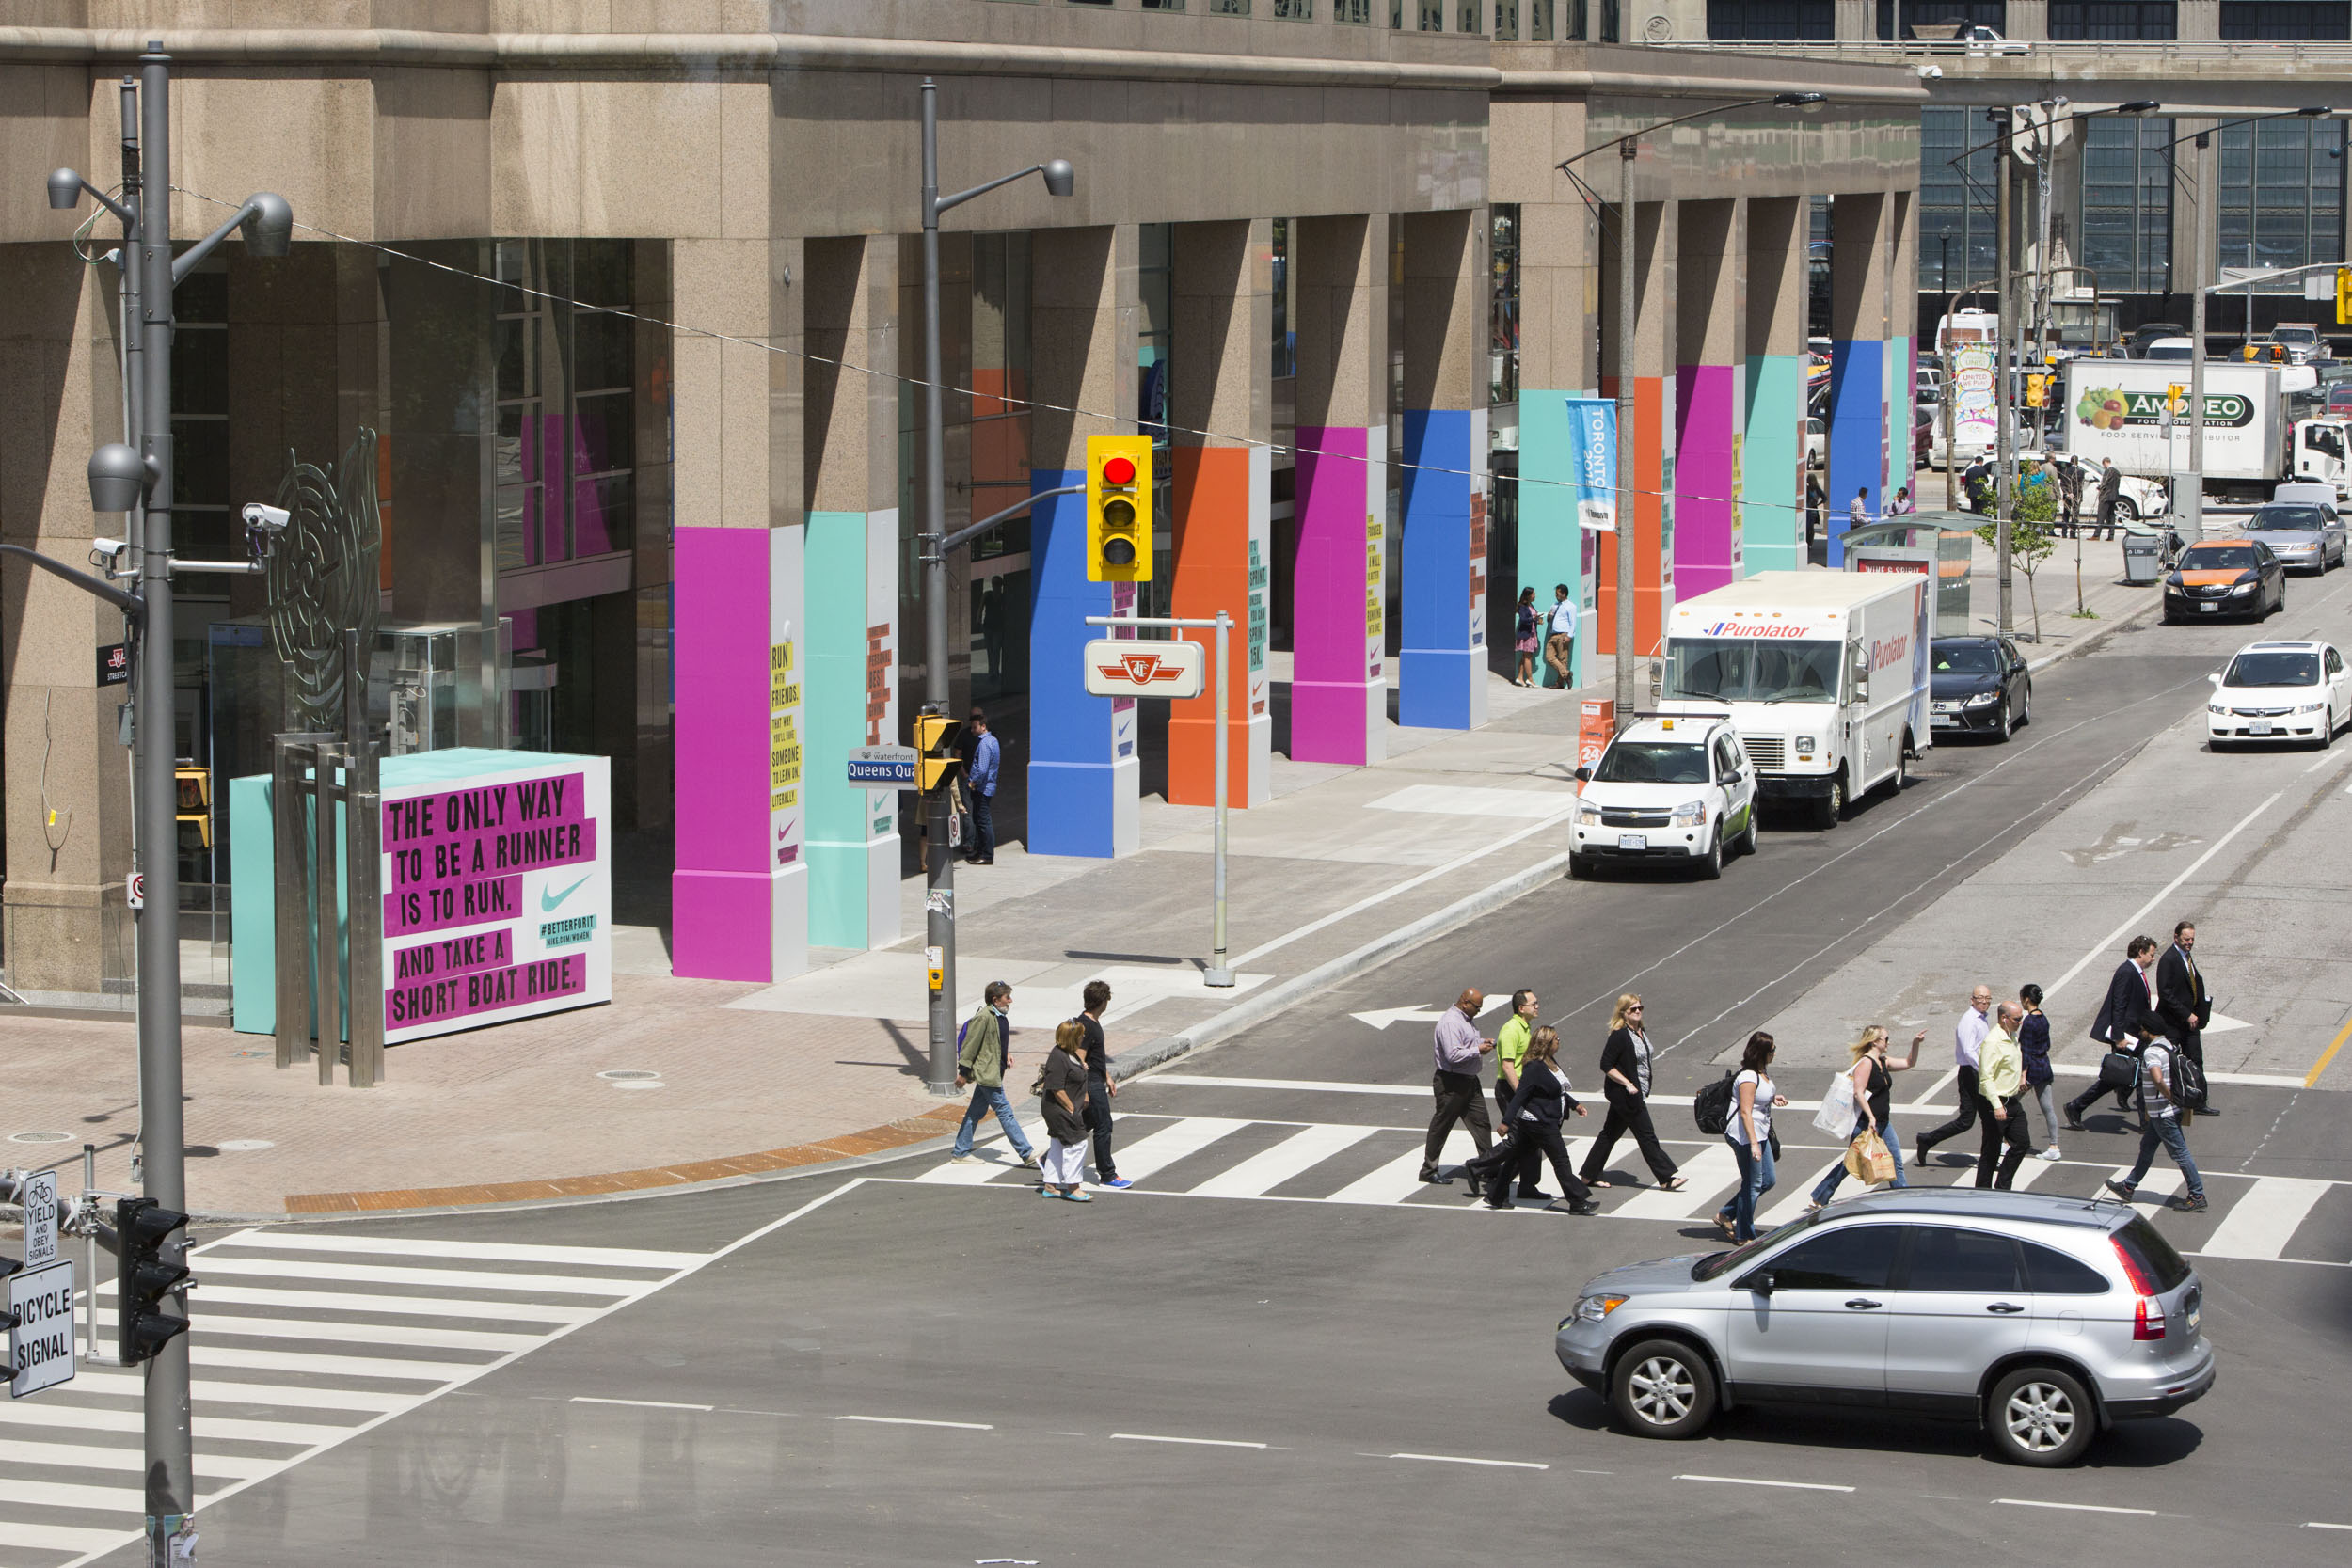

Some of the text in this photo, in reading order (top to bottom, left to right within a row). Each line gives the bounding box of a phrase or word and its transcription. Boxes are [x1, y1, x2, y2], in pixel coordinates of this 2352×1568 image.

[1592, 408, 1605, 488] TORONTO
[1583, 450, 1593, 487] 2015
[1250, 567, 1266, 586] SPRINT.
[1250, 624, 1265, 642] SPRINT
[1722, 622, 1810, 638] Purolator
[772, 644, 788, 670] RUN
[1875, 632, 1907, 671] Purolator
[107, 671, 127, 681] STREETCA
[869, 668, 883, 688] BEST
[772, 685, 799, 708] FRIENDS.
[772, 715, 792, 730] THAT WAY
[772, 745, 799, 767] SOMEONE
[773, 771, 779, 785] TO
[779, 767, 791, 783] LEAN
[848, 763, 915, 778] Queens Qua
[389, 779, 564, 841] THE ONLY WAY
[397, 824, 580, 885] TO BE A RUNNER
[402, 879, 511, 927] IS TO RUN.
[542, 915, 593, 936] #BETTERFORIT
[398, 933, 504, 979] AND TAKE A
[393, 958, 576, 1022] SHORT BOAT RIDE.
[27, 1204, 55, 1225] YIELD
[35, 1224, 48, 1235] AND
[33, 1235, 50, 1249] OBEY
[28, 1245, 54, 1261] SIGNALS
[13, 1289, 70, 1328] BICYCLE
[17, 1332, 68, 1370] SIGNAL
